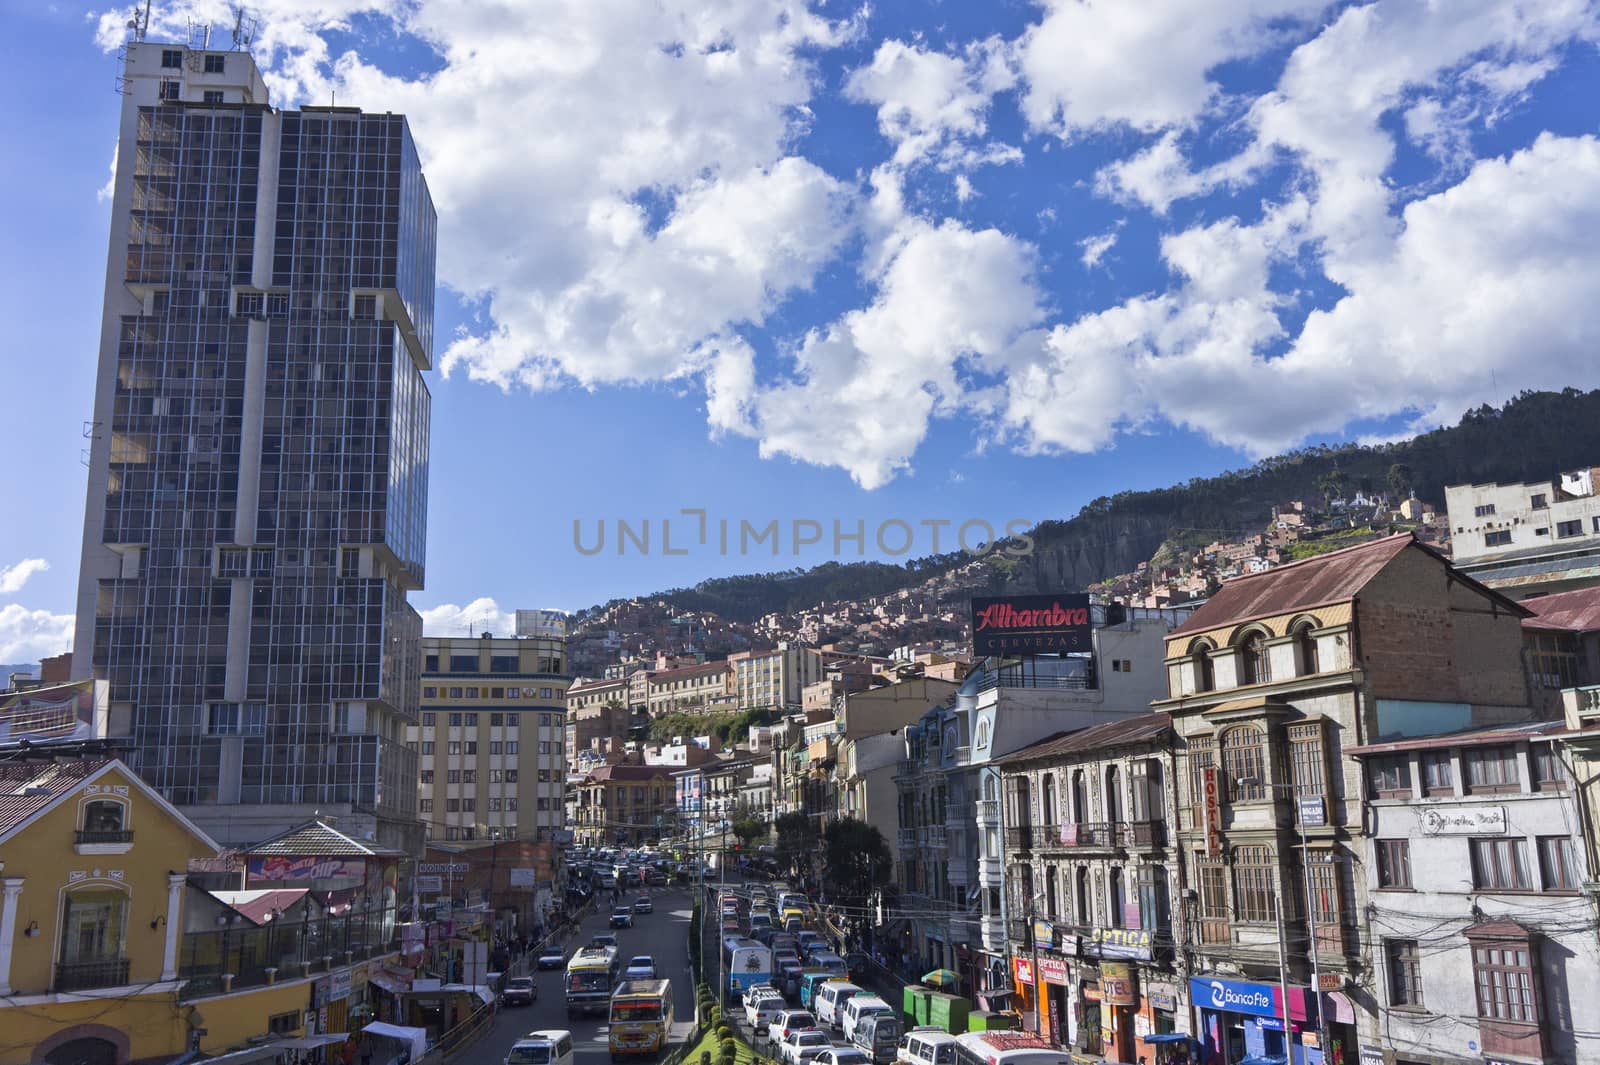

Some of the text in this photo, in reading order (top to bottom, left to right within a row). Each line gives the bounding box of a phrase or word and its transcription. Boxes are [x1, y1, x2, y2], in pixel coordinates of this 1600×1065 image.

[975, 602, 1087, 632] Alhambra
[988, 637, 1078, 648] CERVEZAS
[1205, 769, 1218, 849] HOSTAL
[1092, 928, 1151, 948] OPTICA
[1038, 958, 1066, 970] OPTICA
